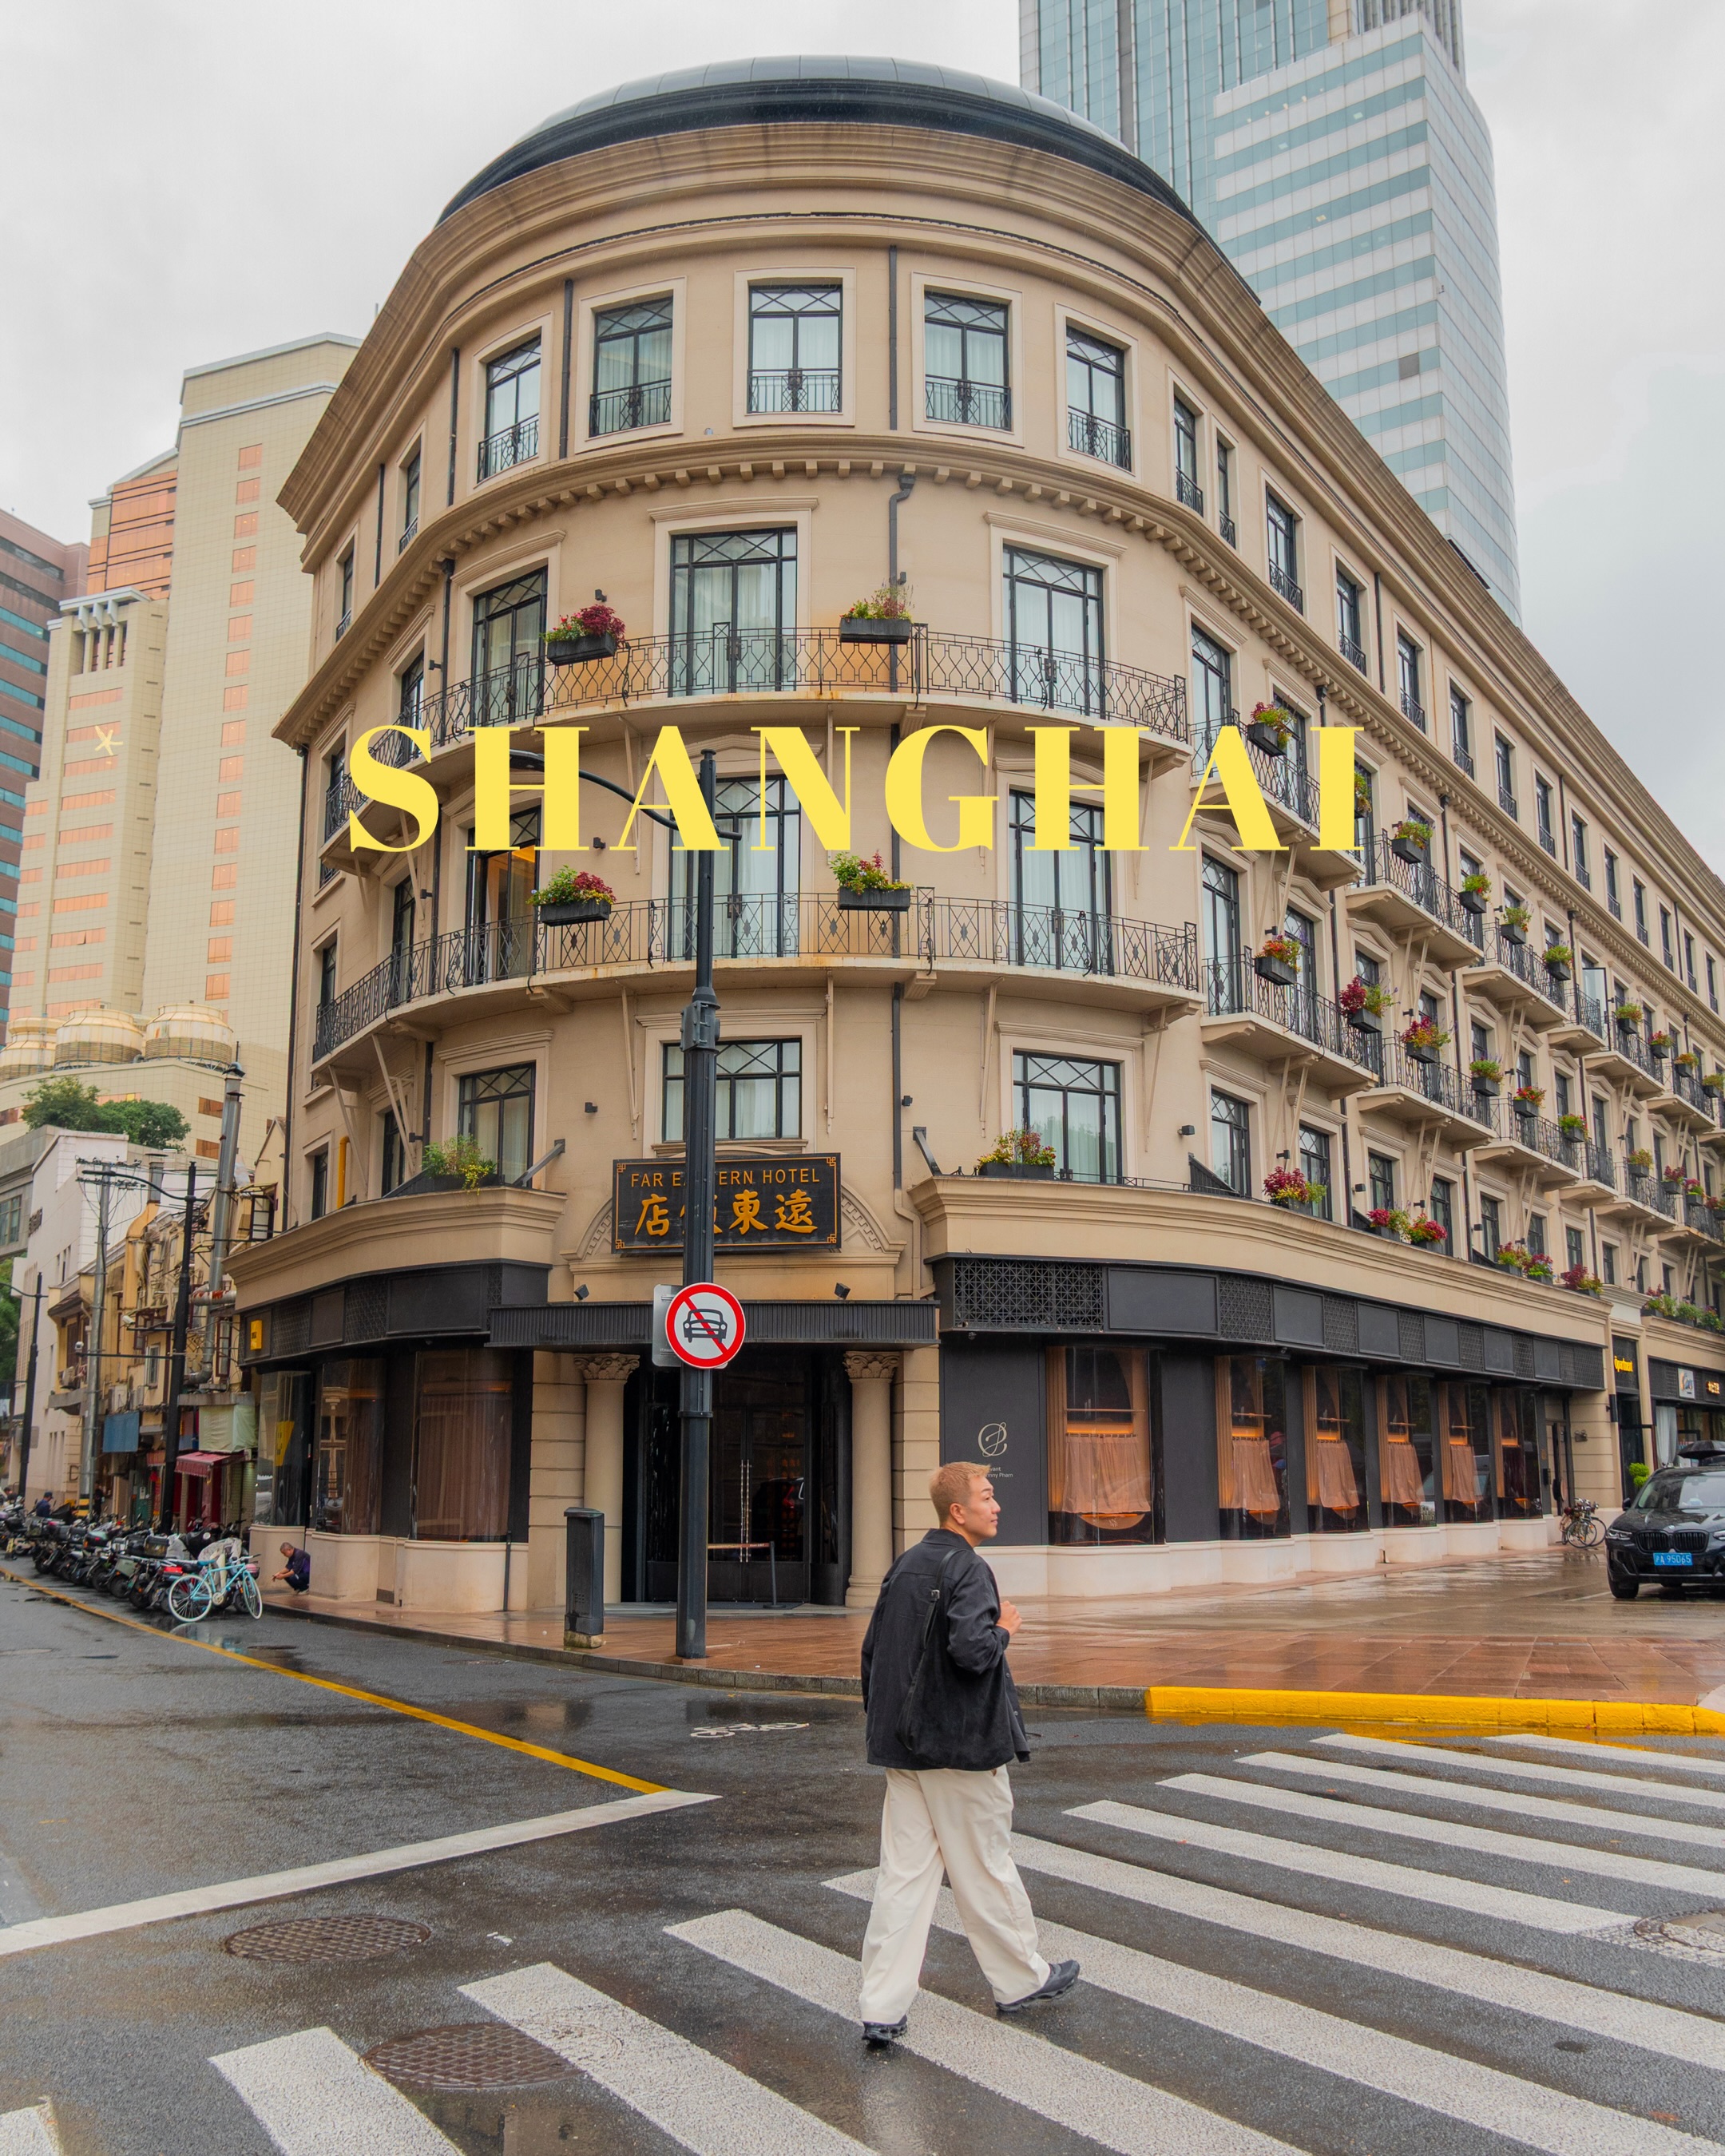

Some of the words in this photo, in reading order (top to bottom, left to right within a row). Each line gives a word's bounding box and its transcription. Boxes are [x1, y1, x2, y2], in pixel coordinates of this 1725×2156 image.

[631, 1173, 664, 1187] FAR
[672, 1170, 754, 1187] EERN
[763, 1168, 820, 1184] HOTEL
